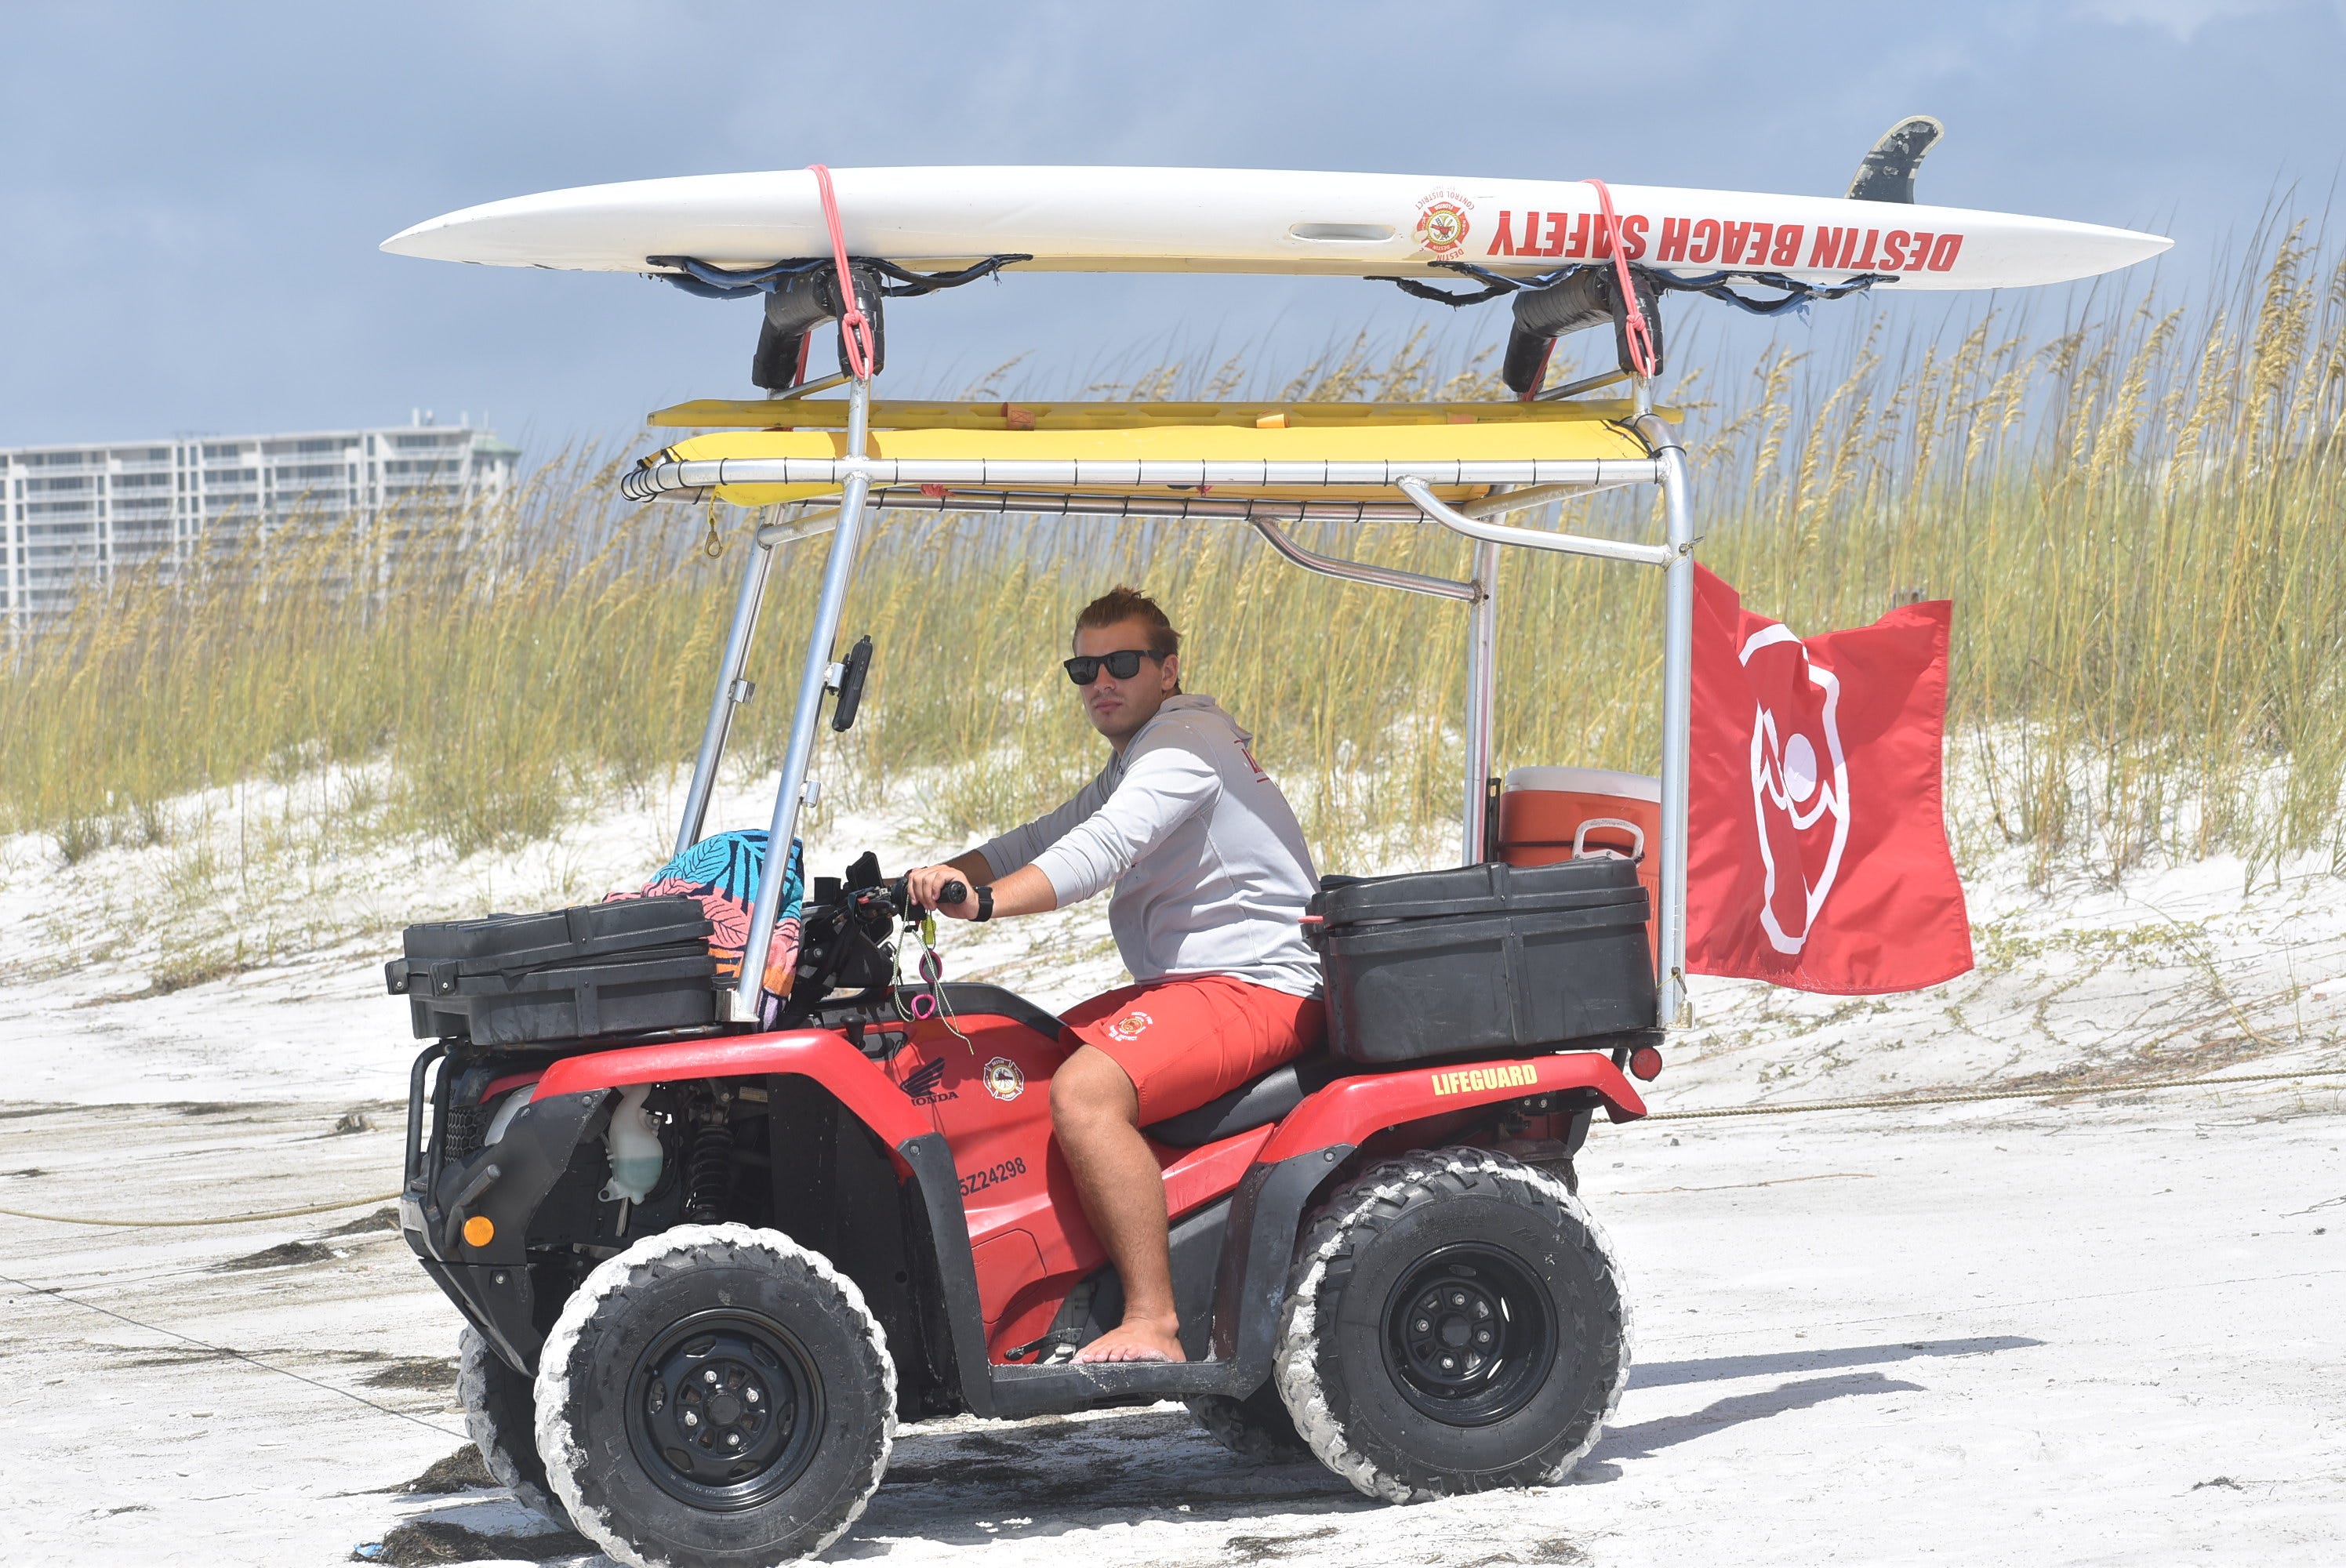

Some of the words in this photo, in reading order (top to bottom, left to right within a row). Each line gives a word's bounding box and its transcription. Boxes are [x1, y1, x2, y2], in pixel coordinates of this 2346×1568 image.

[1415, 191, 1444, 210] DISTRICT
[1447, 191, 1475, 210] CONTROL
[1487, 210, 1650, 260] SAFETY
[1656, 216, 1805, 267] BEACH
[1808, 226, 1963, 271] DESTIN
[1436, 248, 1465, 261] DESTIN
[1431, 1064, 1538, 1096] LIFEGUARD
[959, 1156, 1026, 1196] 5Z24298
